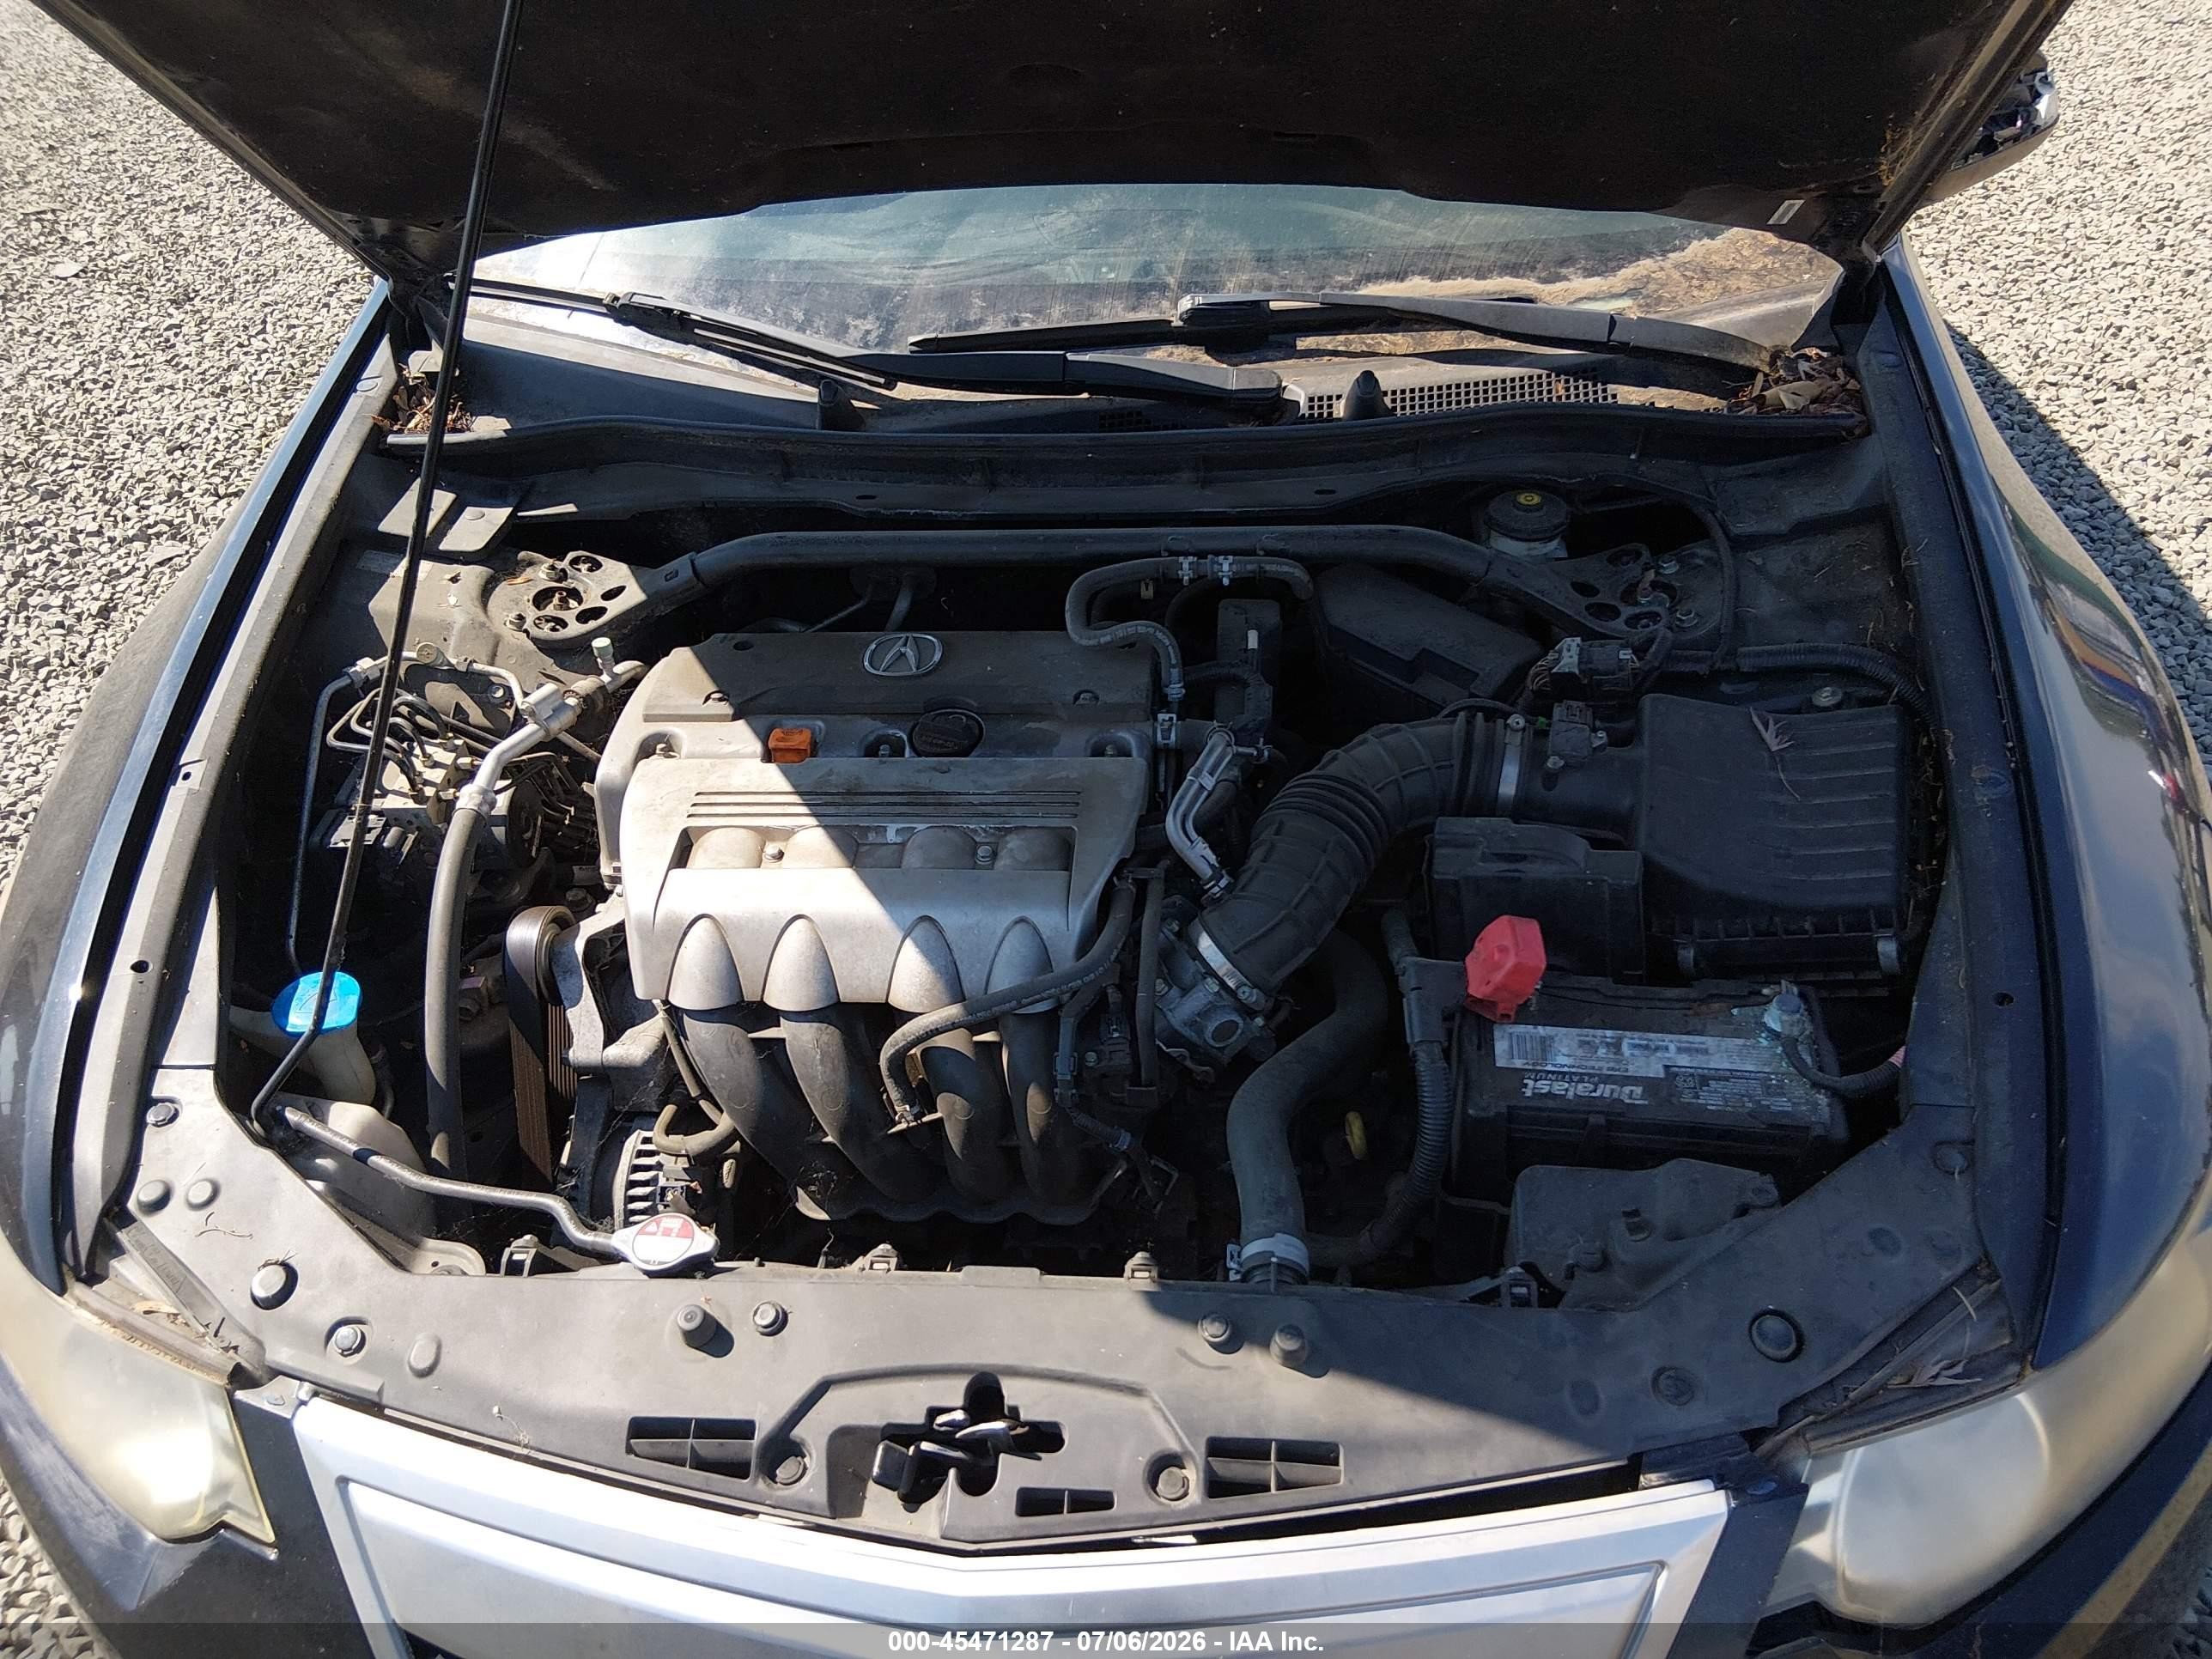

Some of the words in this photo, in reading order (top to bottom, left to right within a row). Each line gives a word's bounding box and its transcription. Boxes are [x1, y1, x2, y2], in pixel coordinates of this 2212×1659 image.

[1522, 1060, 1601, 1072] TECHNOLOGY
[1523, 1072, 1601, 1083] PLATINUM
[1521, 1078, 1649, 1105] Duralast
